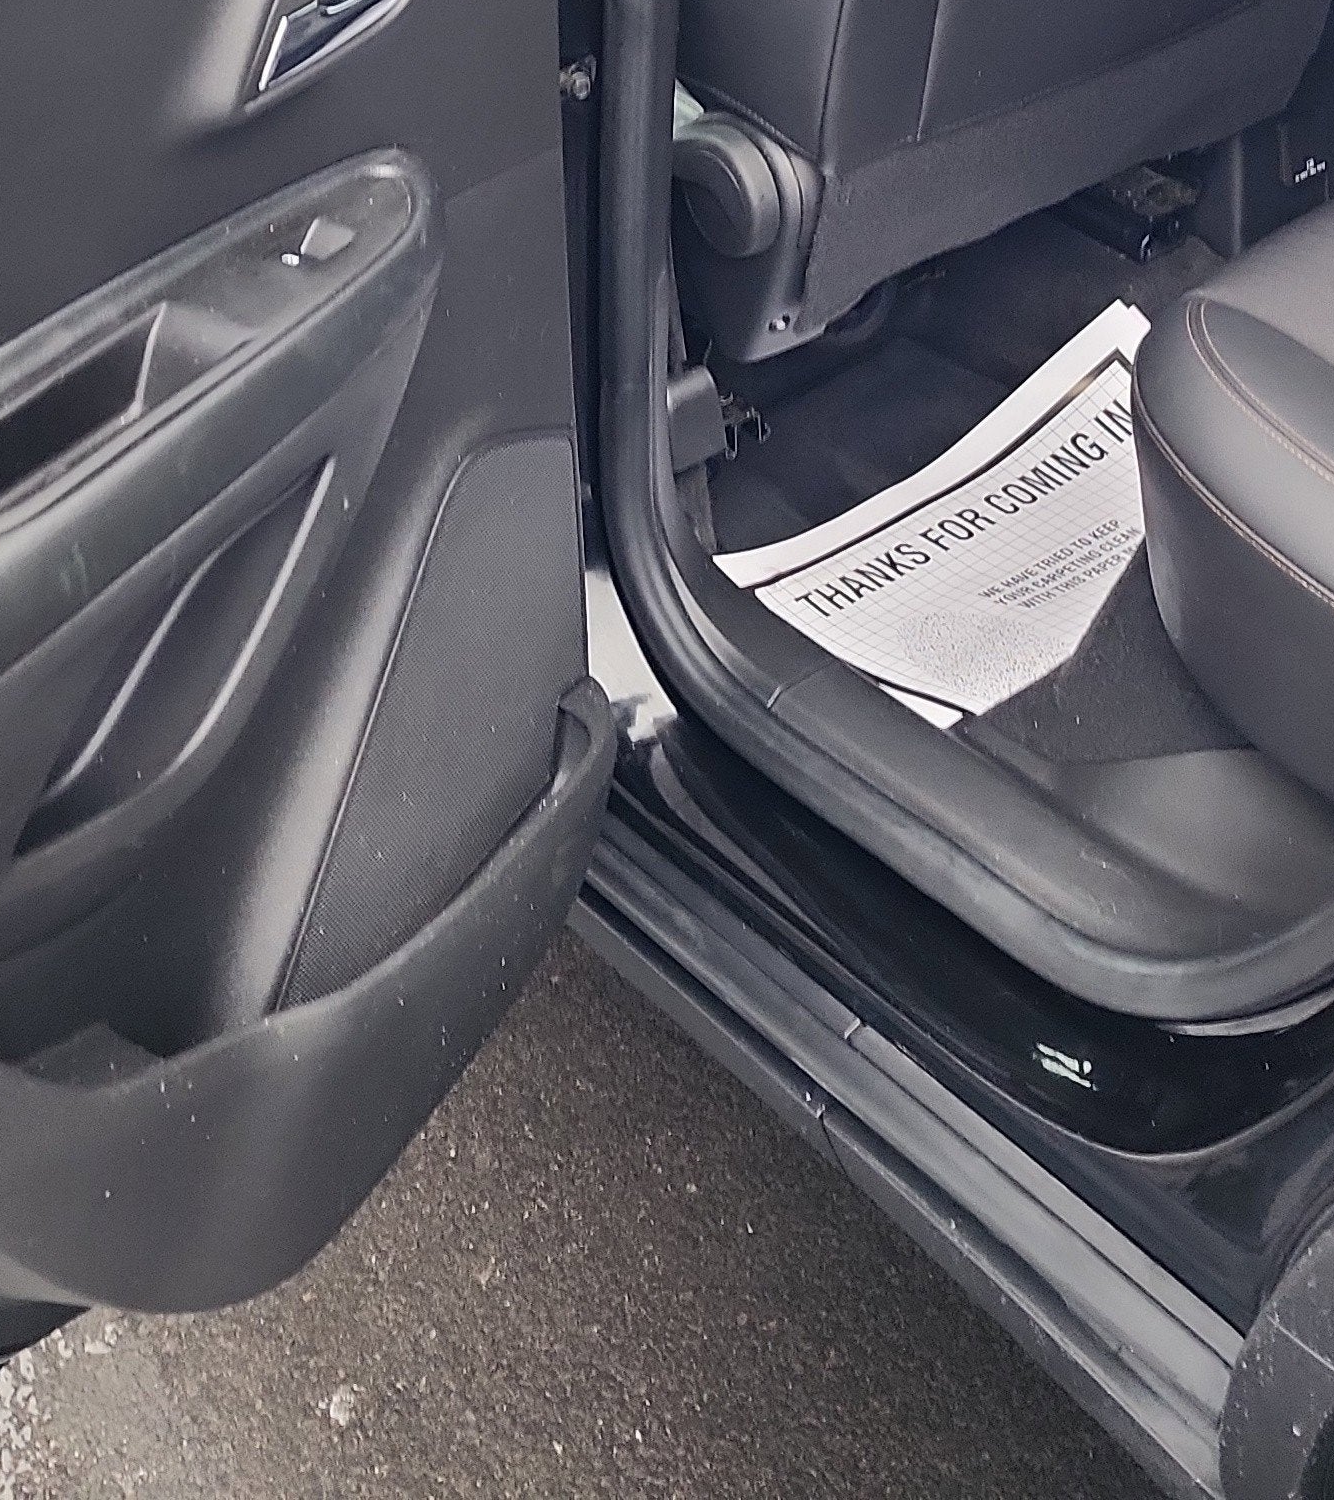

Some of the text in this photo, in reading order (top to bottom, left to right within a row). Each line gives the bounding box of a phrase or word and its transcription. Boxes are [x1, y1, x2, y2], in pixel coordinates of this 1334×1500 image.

[794, 399, 1133, 617] THANKS FOR COMING IN
[978, 519, 1121, 599] WE HAVE TRIED TO KEEP
[994, 583, 1035, 606] YOUR
[1032, 548, 1102, 589] CARPETING
[1099, 526, 1141, 552] CLEAN
[1018, 553, 1123, 609] WITH THIS PAPER
